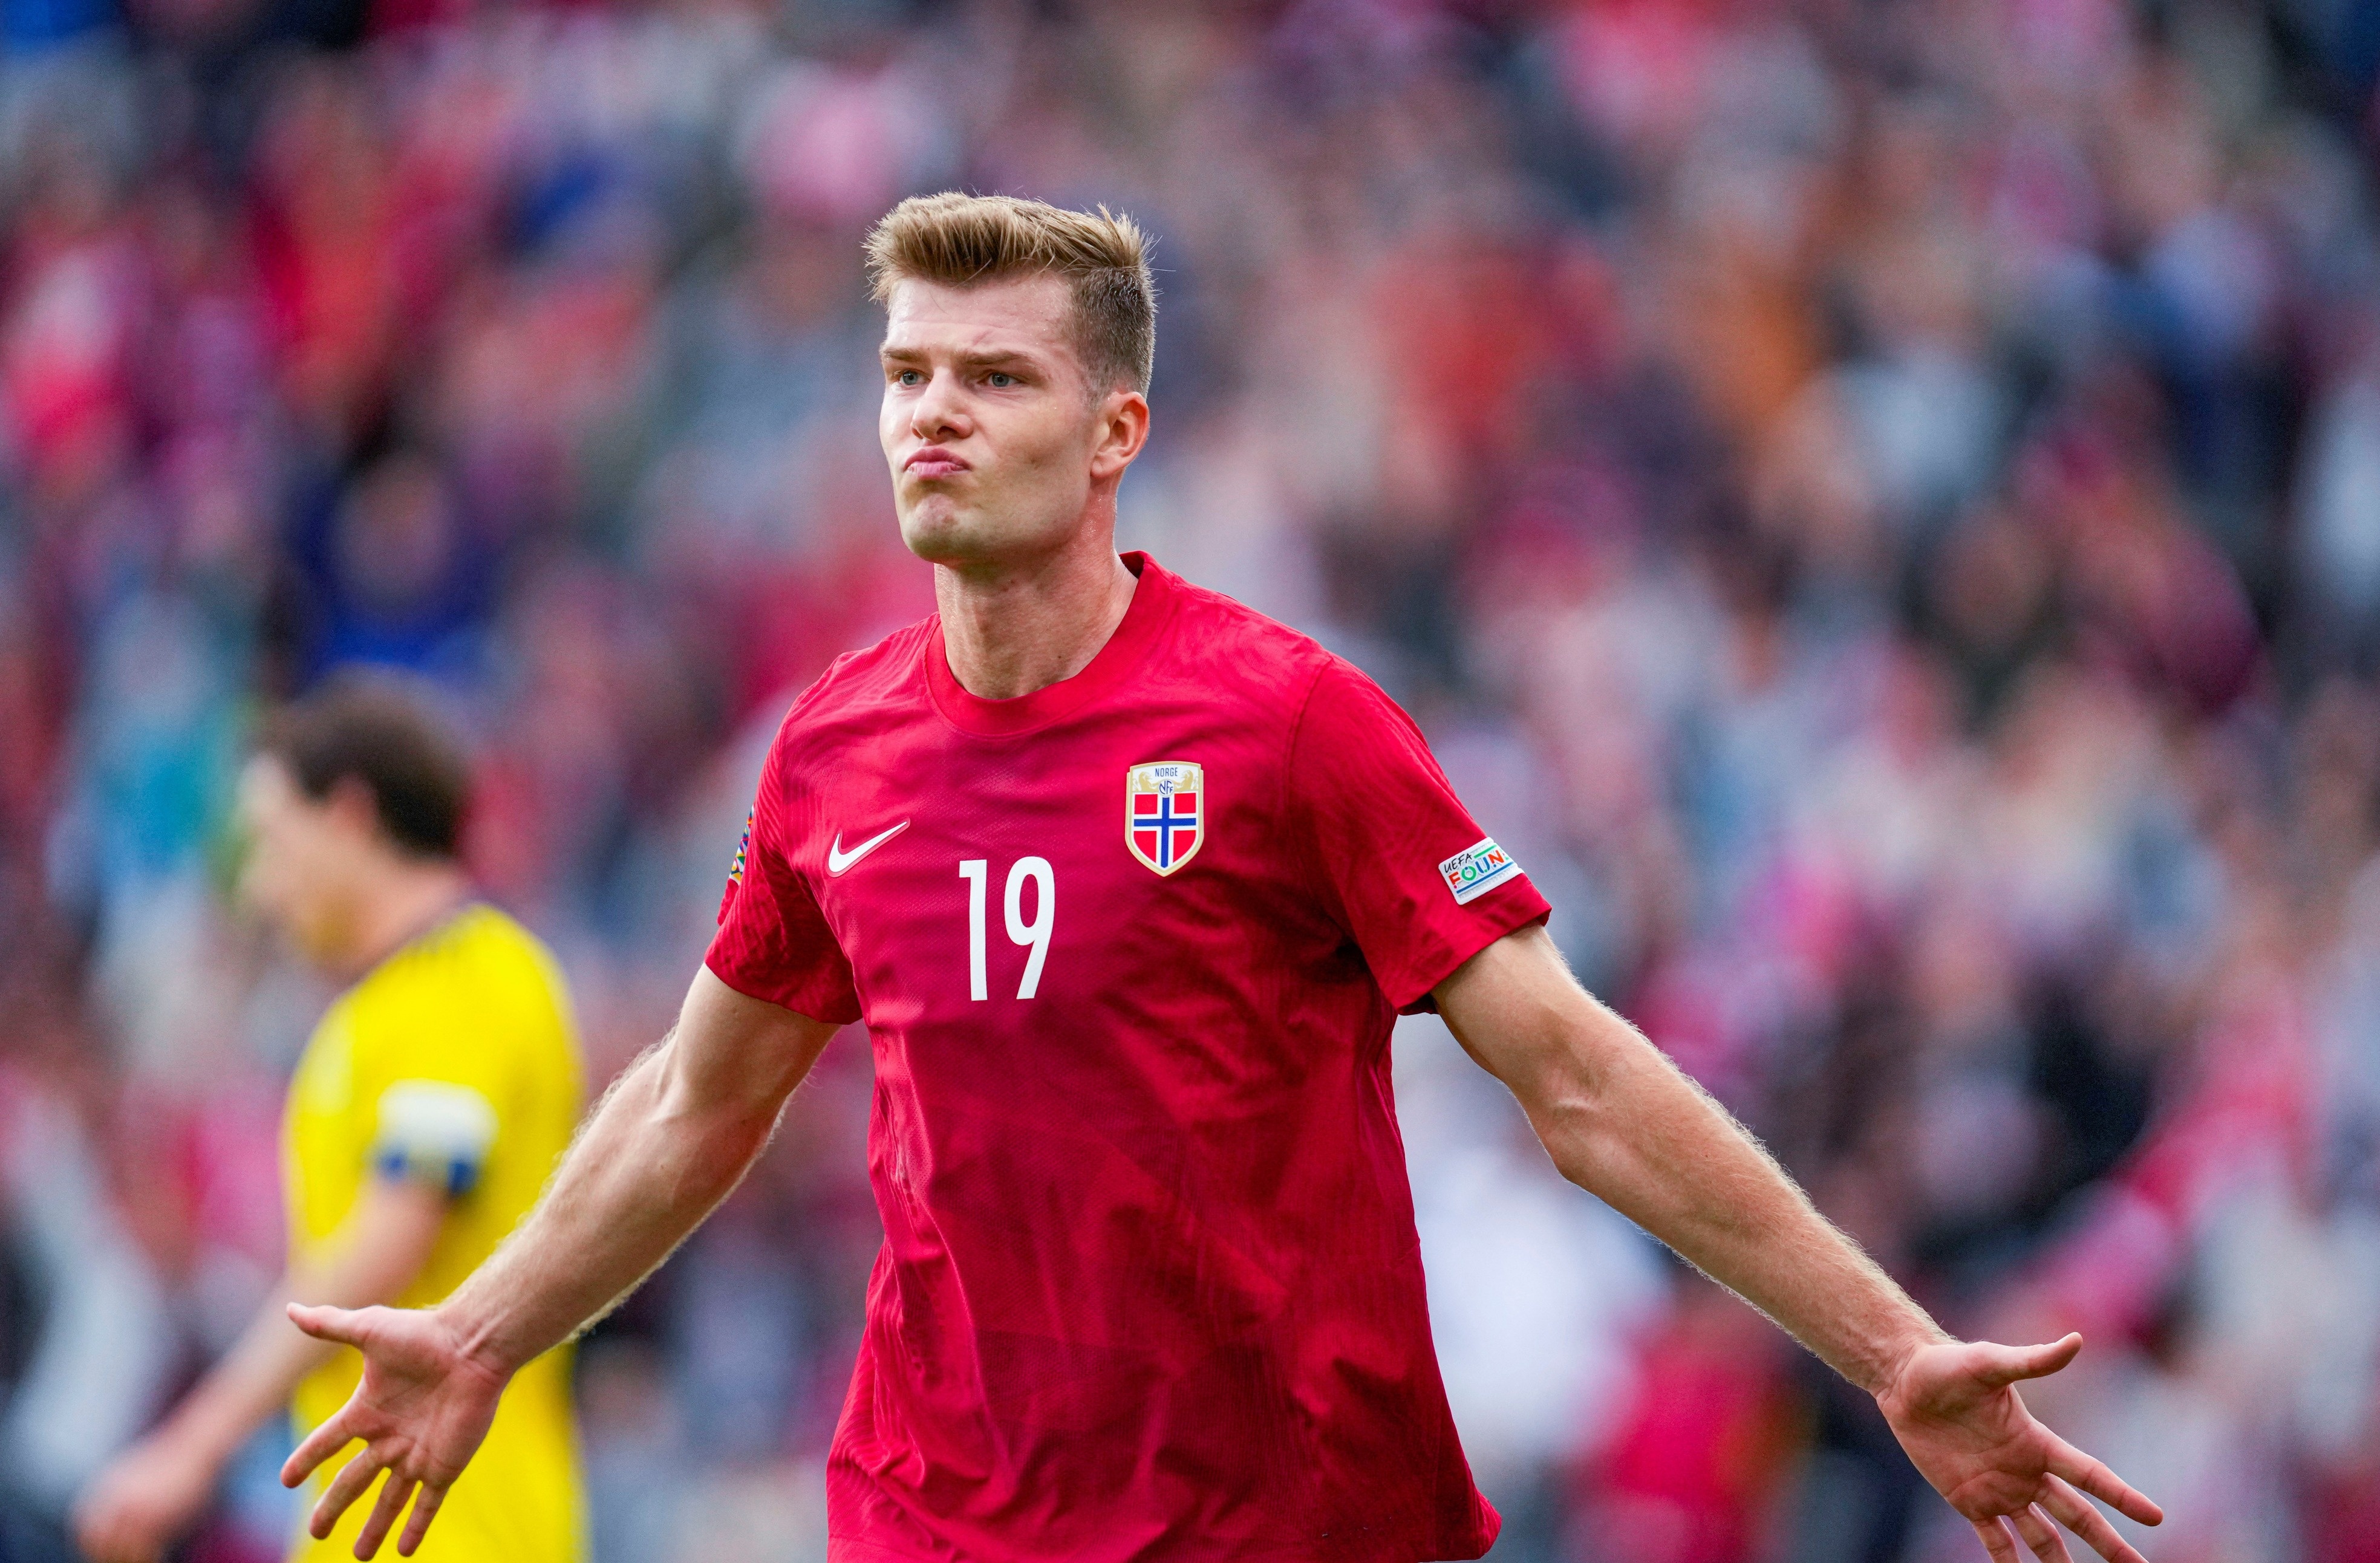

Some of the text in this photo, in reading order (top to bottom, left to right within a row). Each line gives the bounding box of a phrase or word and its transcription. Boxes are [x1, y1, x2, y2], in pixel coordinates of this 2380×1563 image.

[1155, 767, 1178, 777] NORGE
[1444, 853, 1472, 873] UEFA
[1448, 850, 1508, 889] FOUN
[959, 856, 1055, 1001] 19
